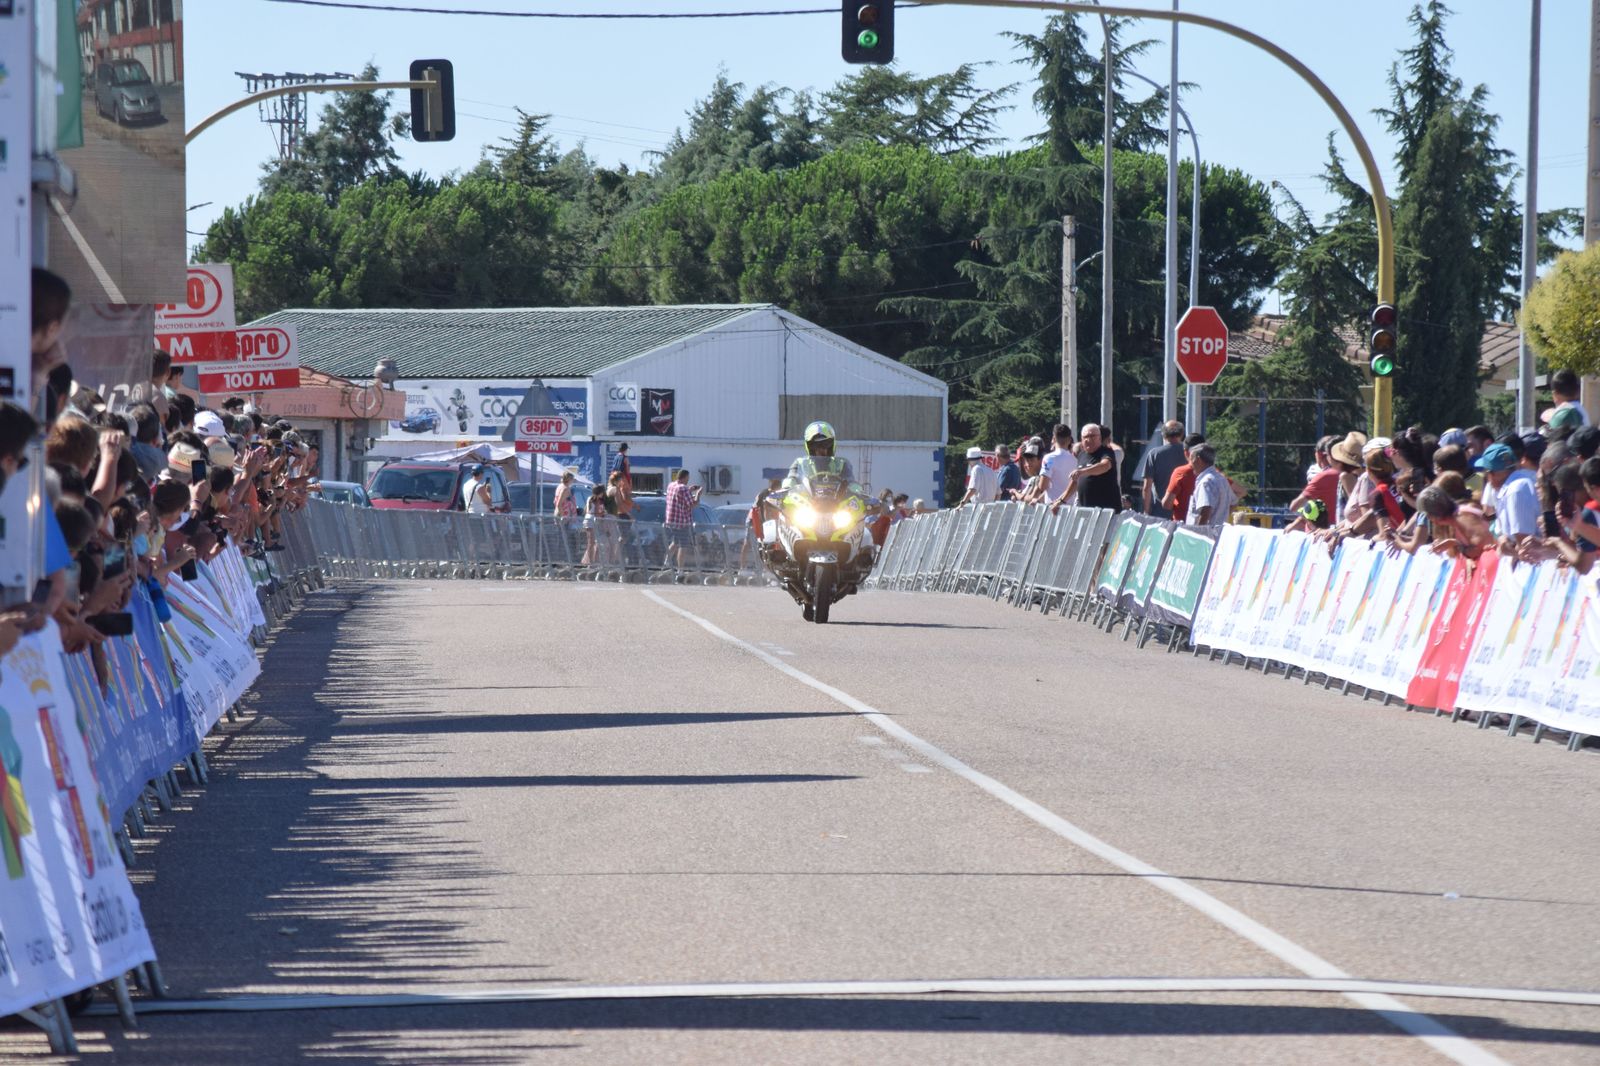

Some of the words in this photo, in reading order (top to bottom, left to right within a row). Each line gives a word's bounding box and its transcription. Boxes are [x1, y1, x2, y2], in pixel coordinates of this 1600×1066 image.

[170, 336, 194, 357] M
[236, 333, 279, 362] pro
[1180, 337, 1224, 355] STOP
[224, 372, 254, 388] 100
[259, 372, 276, 386] M
[526, 420, 562, 436] aspro
[528, 442, 547, 452] 200
[550, 442, 558, 452] M
